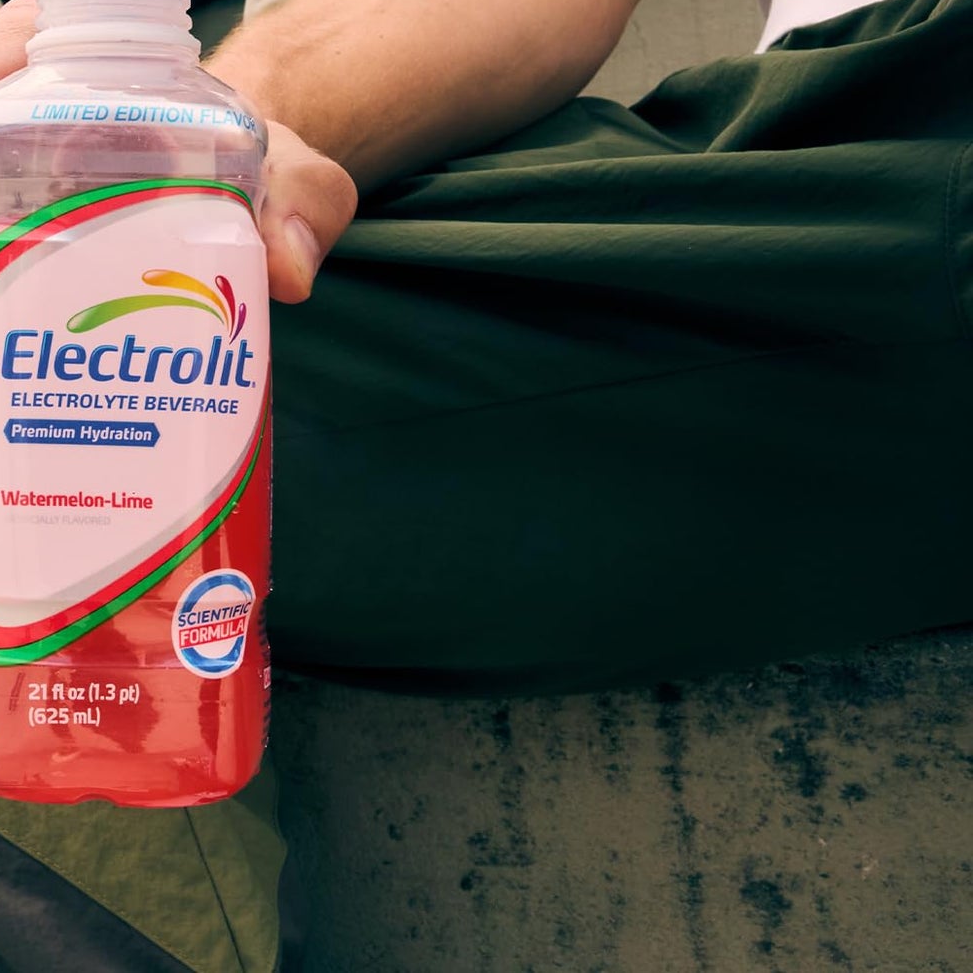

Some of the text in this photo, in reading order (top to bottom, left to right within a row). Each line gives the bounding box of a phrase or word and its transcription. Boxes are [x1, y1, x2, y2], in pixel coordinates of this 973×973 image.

[31, 104, 108, 121] LIMITED
[114, 105, 193, 123] EDITION
[1, 329, 255, 388] Electrolit
[10, 391, 239, 414] ELECTROLYTE BEVERAGE
[11, 423, 152, 443] Premium Hydration
[1, 490, 154, 510] Watermelon-Lime
[178, 602, 252, 627] SCIENTIFIC
[180, 620, 245, 647] FORMULA
[28, 683, 140, 705] 21 fl oz (1.3 pt)
[28, 707, 101, 727] (625 mL)
